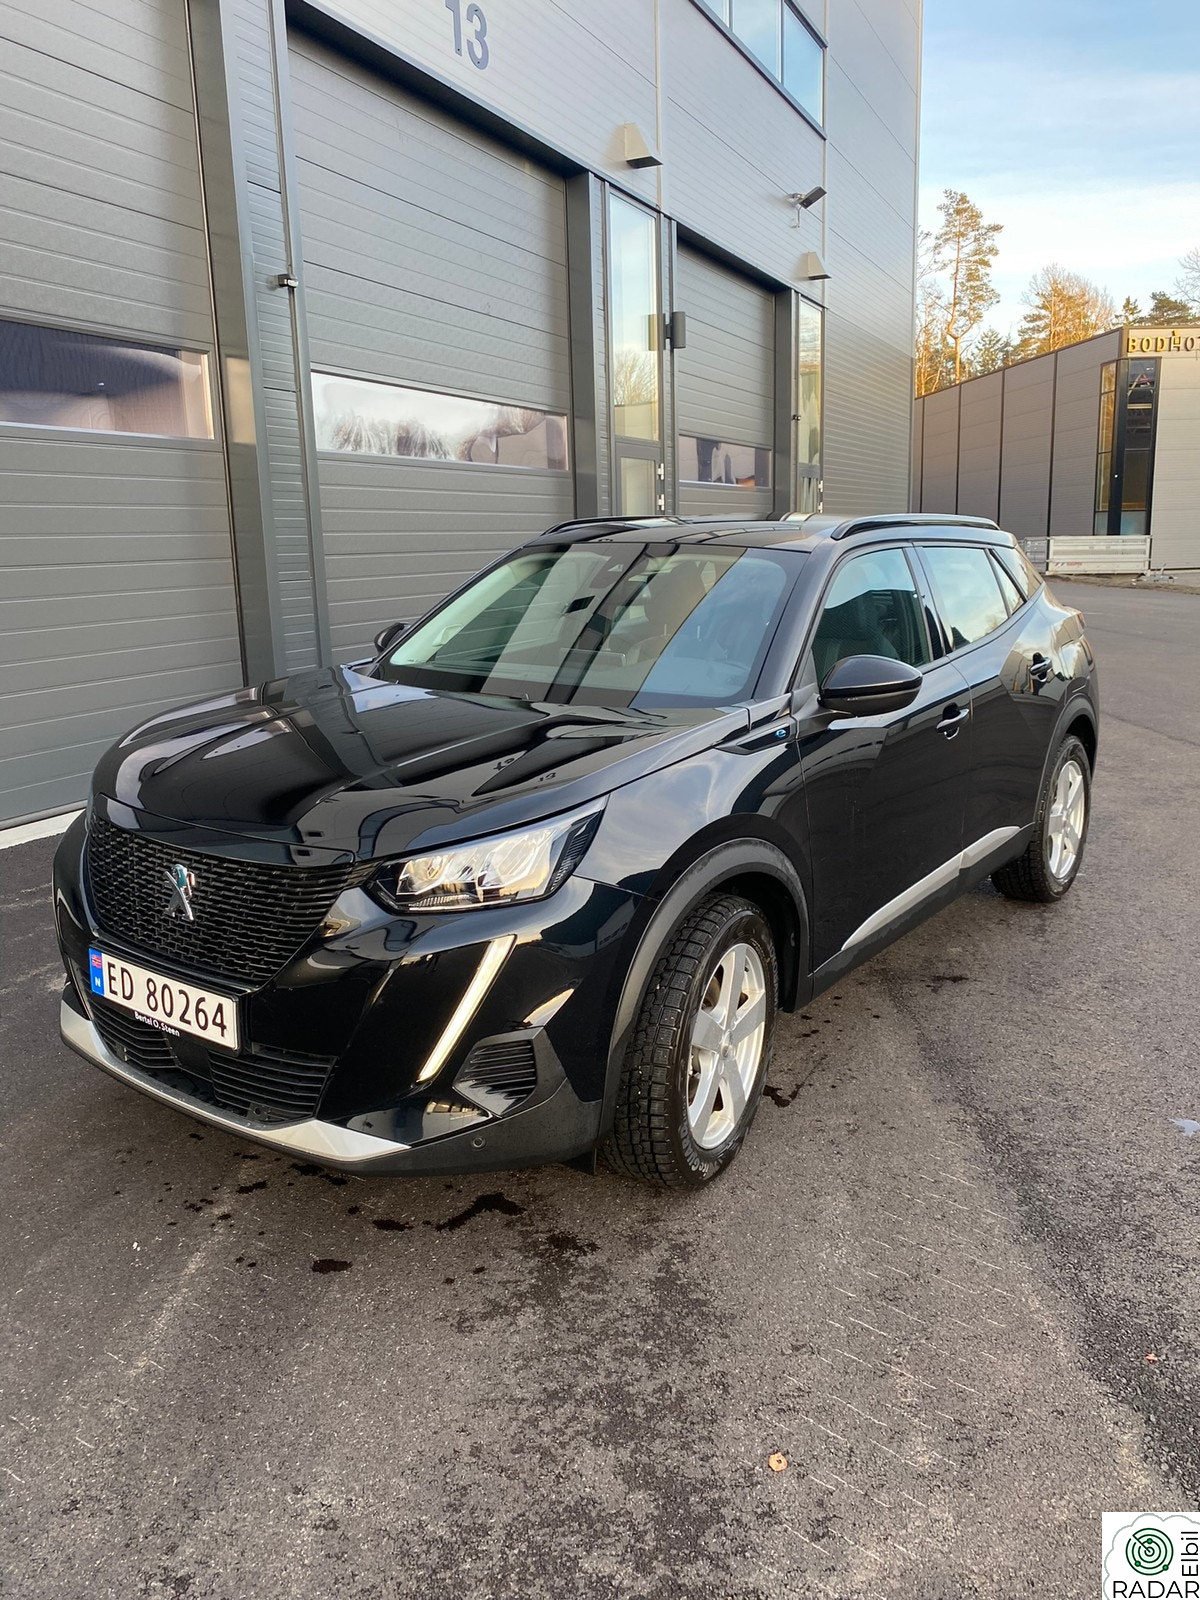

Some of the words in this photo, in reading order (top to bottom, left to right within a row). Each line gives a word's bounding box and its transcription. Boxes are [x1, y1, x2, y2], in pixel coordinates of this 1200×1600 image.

[445, 0, 489, 70] 13
[1127, 336, 1200, 353] BODHO
[94, 977, 102, 987] N
[107, 961, 134, 1001] ED
[146, 977, 227, 1038] 80264
[134, 1011, 153, 1026] Bertel
[160, 1022, 180, 1037] Steen
